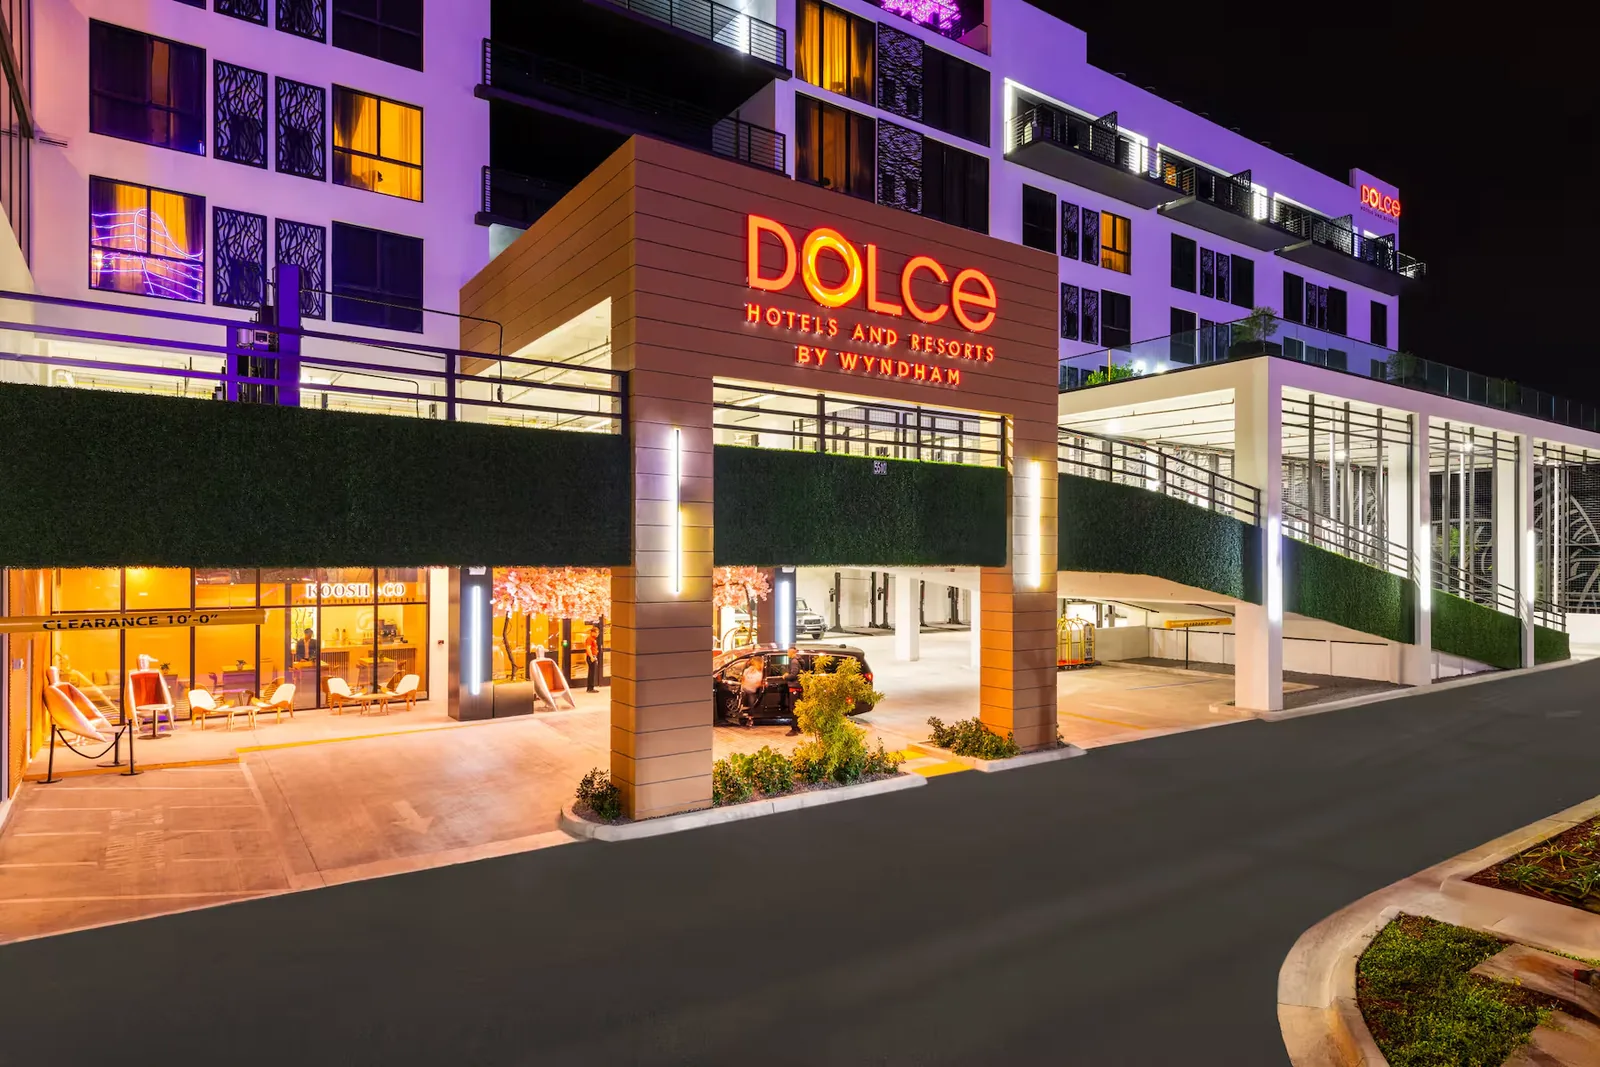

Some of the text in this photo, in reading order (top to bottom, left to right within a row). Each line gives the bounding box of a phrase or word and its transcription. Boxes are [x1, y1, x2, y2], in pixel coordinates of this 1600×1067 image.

[746, 303, 995, 363] HOTELS AND RESORTS
[797, 345, 960, 386] BY WYNDHAM
[306, 582, 370, 598] KOOSH
[384, 582, 405, 597] CO
[42, 615, 159, 631] CLEARANCE
